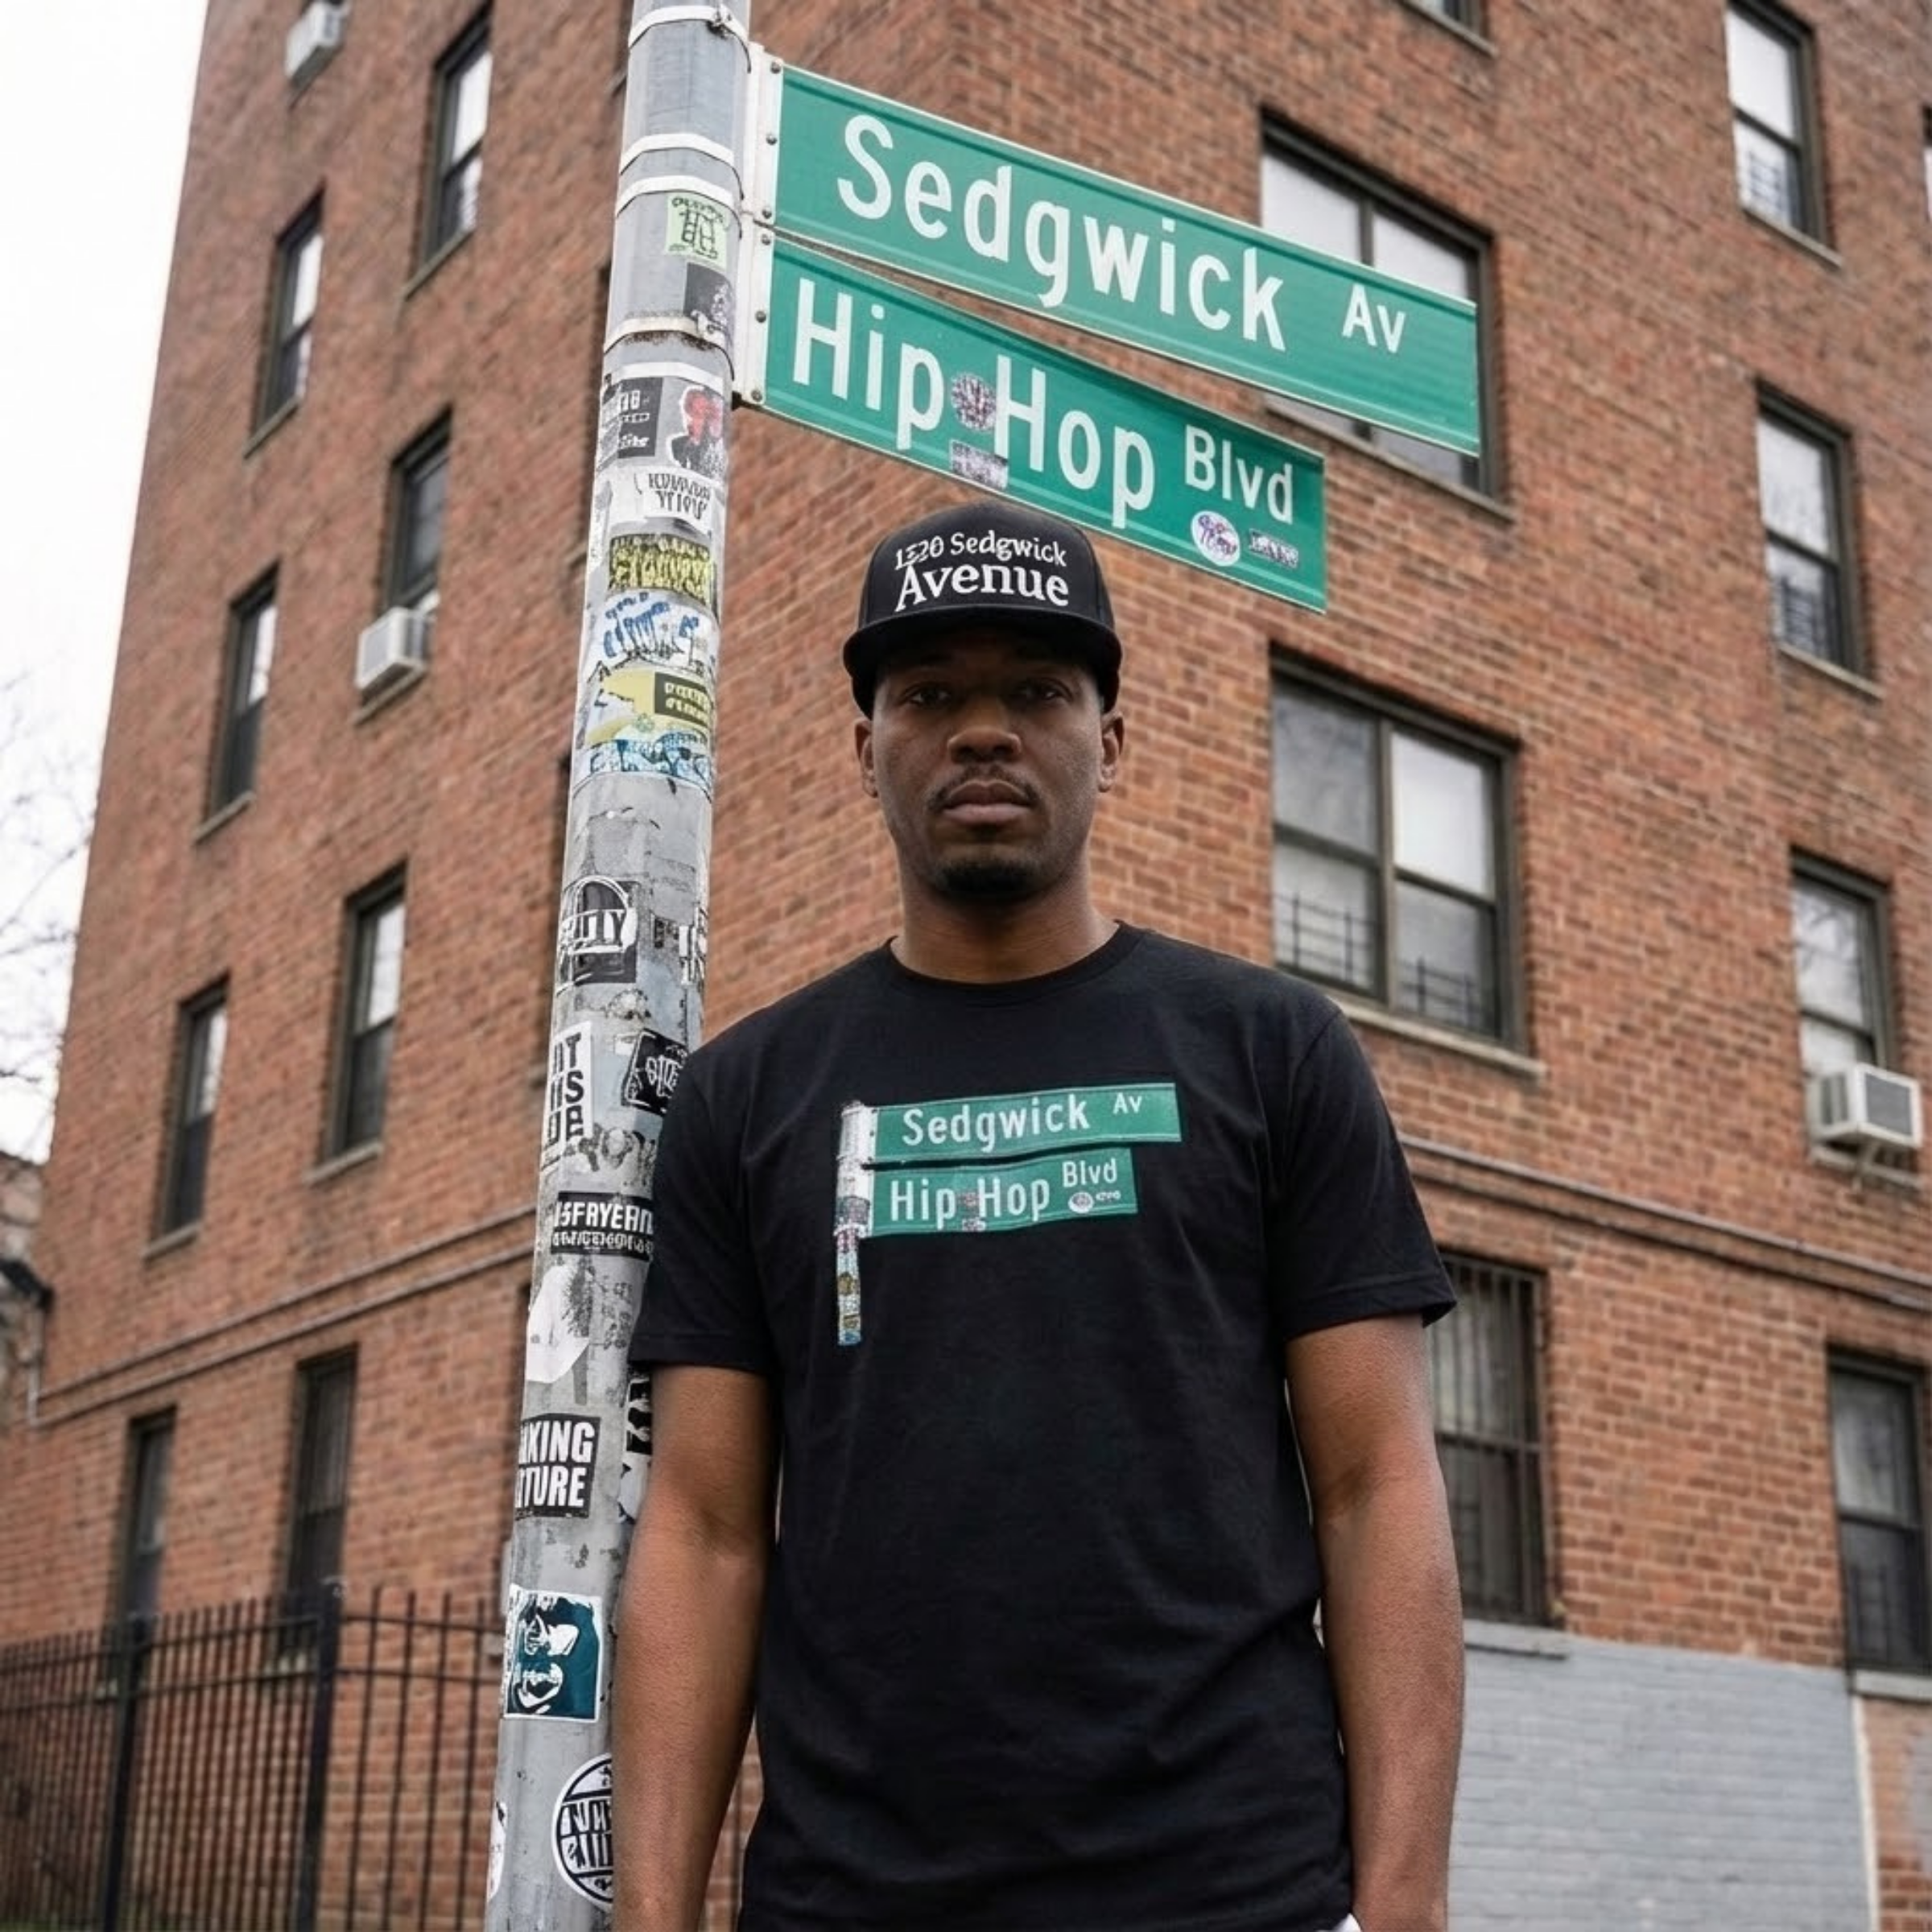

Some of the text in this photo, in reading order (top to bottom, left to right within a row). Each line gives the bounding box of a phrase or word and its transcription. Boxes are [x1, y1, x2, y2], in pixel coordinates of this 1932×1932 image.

[837, 114, 1286, 352] Sedgwick
[1342, 283, 1406, 353] Av
[793, 278, 944, 450] Hip
[994, 354, 1155, 529] Hop
[1185, 424, 1293, 524] Blvd
[951, 530, 1067, 566] Sedgwick
[894, 563, 1070, 612] Avenue
[902, 1092, 1142, 1153] Sedgwick Av
[890, 1158, 1117, 1230] Hip Hop Blvd
